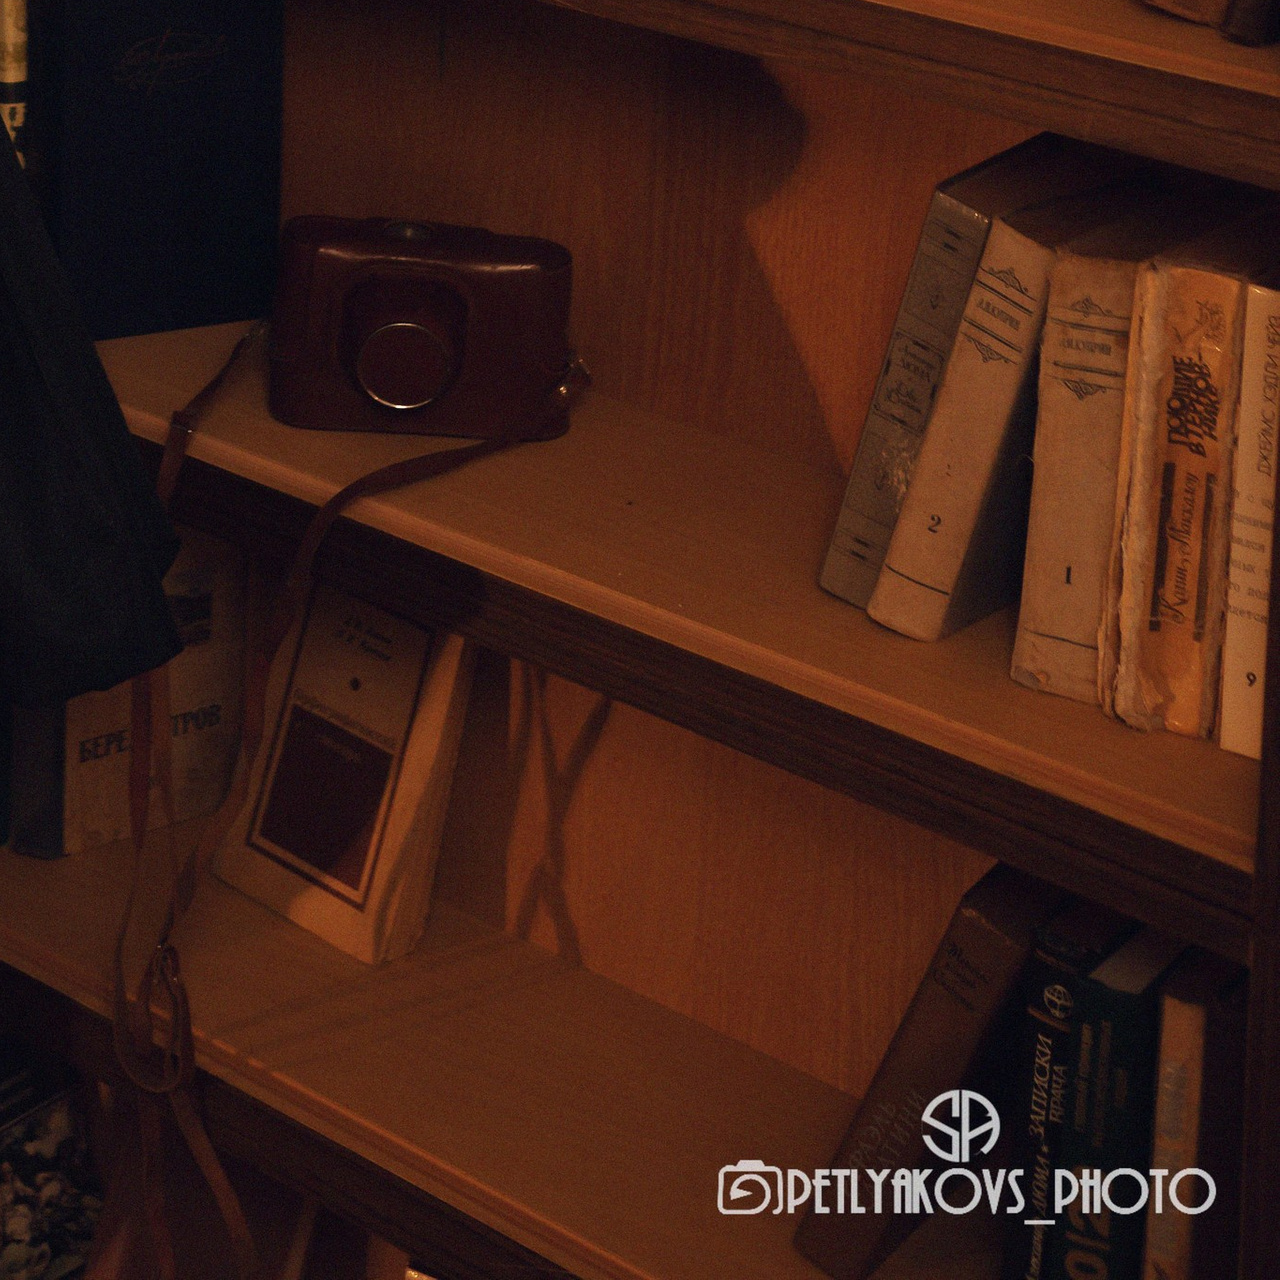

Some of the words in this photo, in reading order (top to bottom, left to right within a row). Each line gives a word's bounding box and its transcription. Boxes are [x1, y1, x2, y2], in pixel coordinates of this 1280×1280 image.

[1267, 315, 1280, 353] ЧЕЙЗ
[1264, 355, 1279, 409] ХЭДЛИ
[1256, 411, 1277, 478] ДЖЕЙМС
[926, 514, 942, 535] 2
[1063, 566, 1072, 588] 1
[1246, 671, 1257, 688] 9
[1028, 1032, 1053, 1139] ЗАПИСКИ
